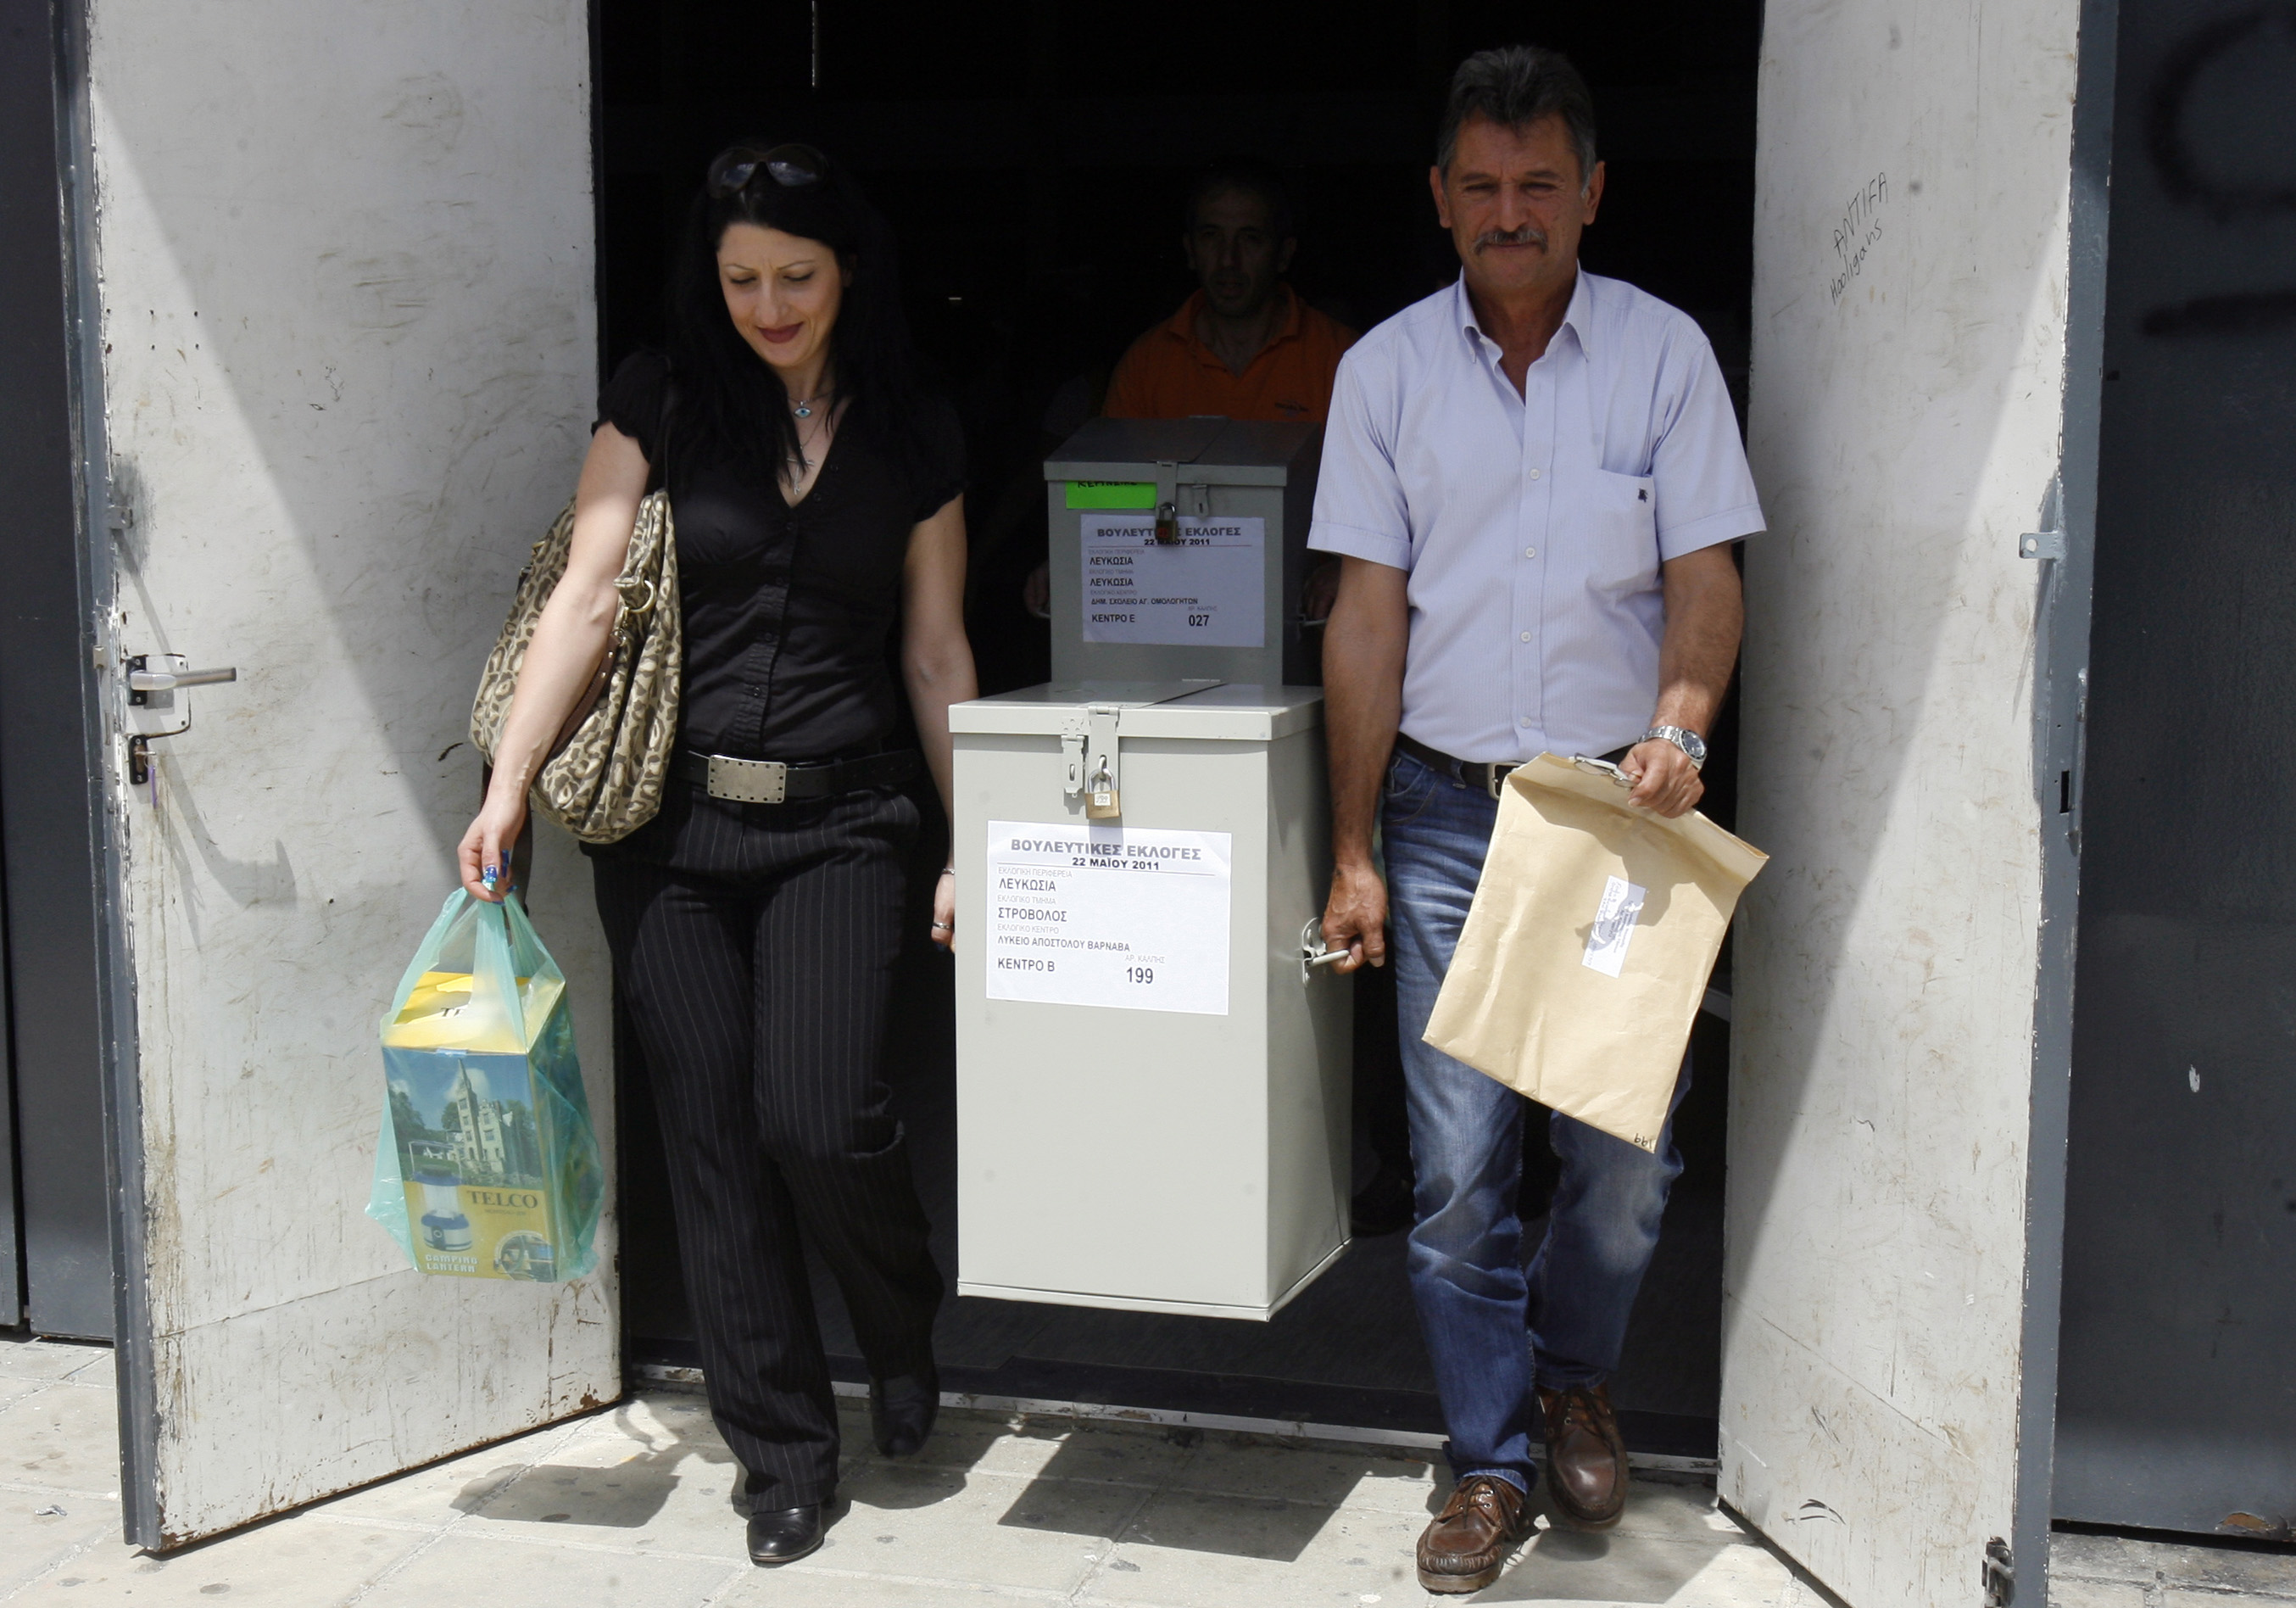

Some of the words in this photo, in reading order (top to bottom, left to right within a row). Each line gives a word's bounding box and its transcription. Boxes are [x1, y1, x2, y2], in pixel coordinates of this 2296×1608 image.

[1833, 171, 1889, 258] ANTIFA
[1185, 527, 1241, 536] ΕΚΛΟΓΕΣ
[1089, 556, 1134, 566] ΛΕΥΚΩΣΙΑ
[1089, 578, 1134, 586] ΛΕΥΚΩΣΙΑ
[1151, 597, 1198, 606] ΟΜΟΛΟΓΗΤΩΝ
[1092, 614, 1128, 623] ΚΕΝΤΡΟ
[1188, 615, 1210, 627] 027
[1011, 839, 1122, 857] ΒΟΥΛΕΥΤΙΚΕΣ
[1127, 845, 1201, 861] ΕΚΛΟΓΕΣ
[1072, 857, 1086, 866] 22
[1089, 857, 1128, 868] ΜΑΪΟΥ
[1132, 861, 1159, 870] 2011
[999, 878, 1056, 891] ΛΕΥΚΩΣΙΑ
[998, 907, 1068, 922] ΣΤΡΟΒΟΛΟΣ
[997, 935, 1030, 946] ΛΥΚΕΙΟ
[1032, 937, 1085, 949] ΑΠΟΣΤΟΛΟΥ
[1088, 941, 1130, 952] ΒΑΡΝΑΒΑ
[997, 958, 1044, 972] ΚΕΝΤΡΟ
[1047, 961, 1056, 972] Β
[1126, 967, 1154, 984] 199
[466, 1190, 538, 1209] TELCO
[425, 1253, 479, 1265] CAMPING
[426, 1262, 476, 1273] LANTERN
